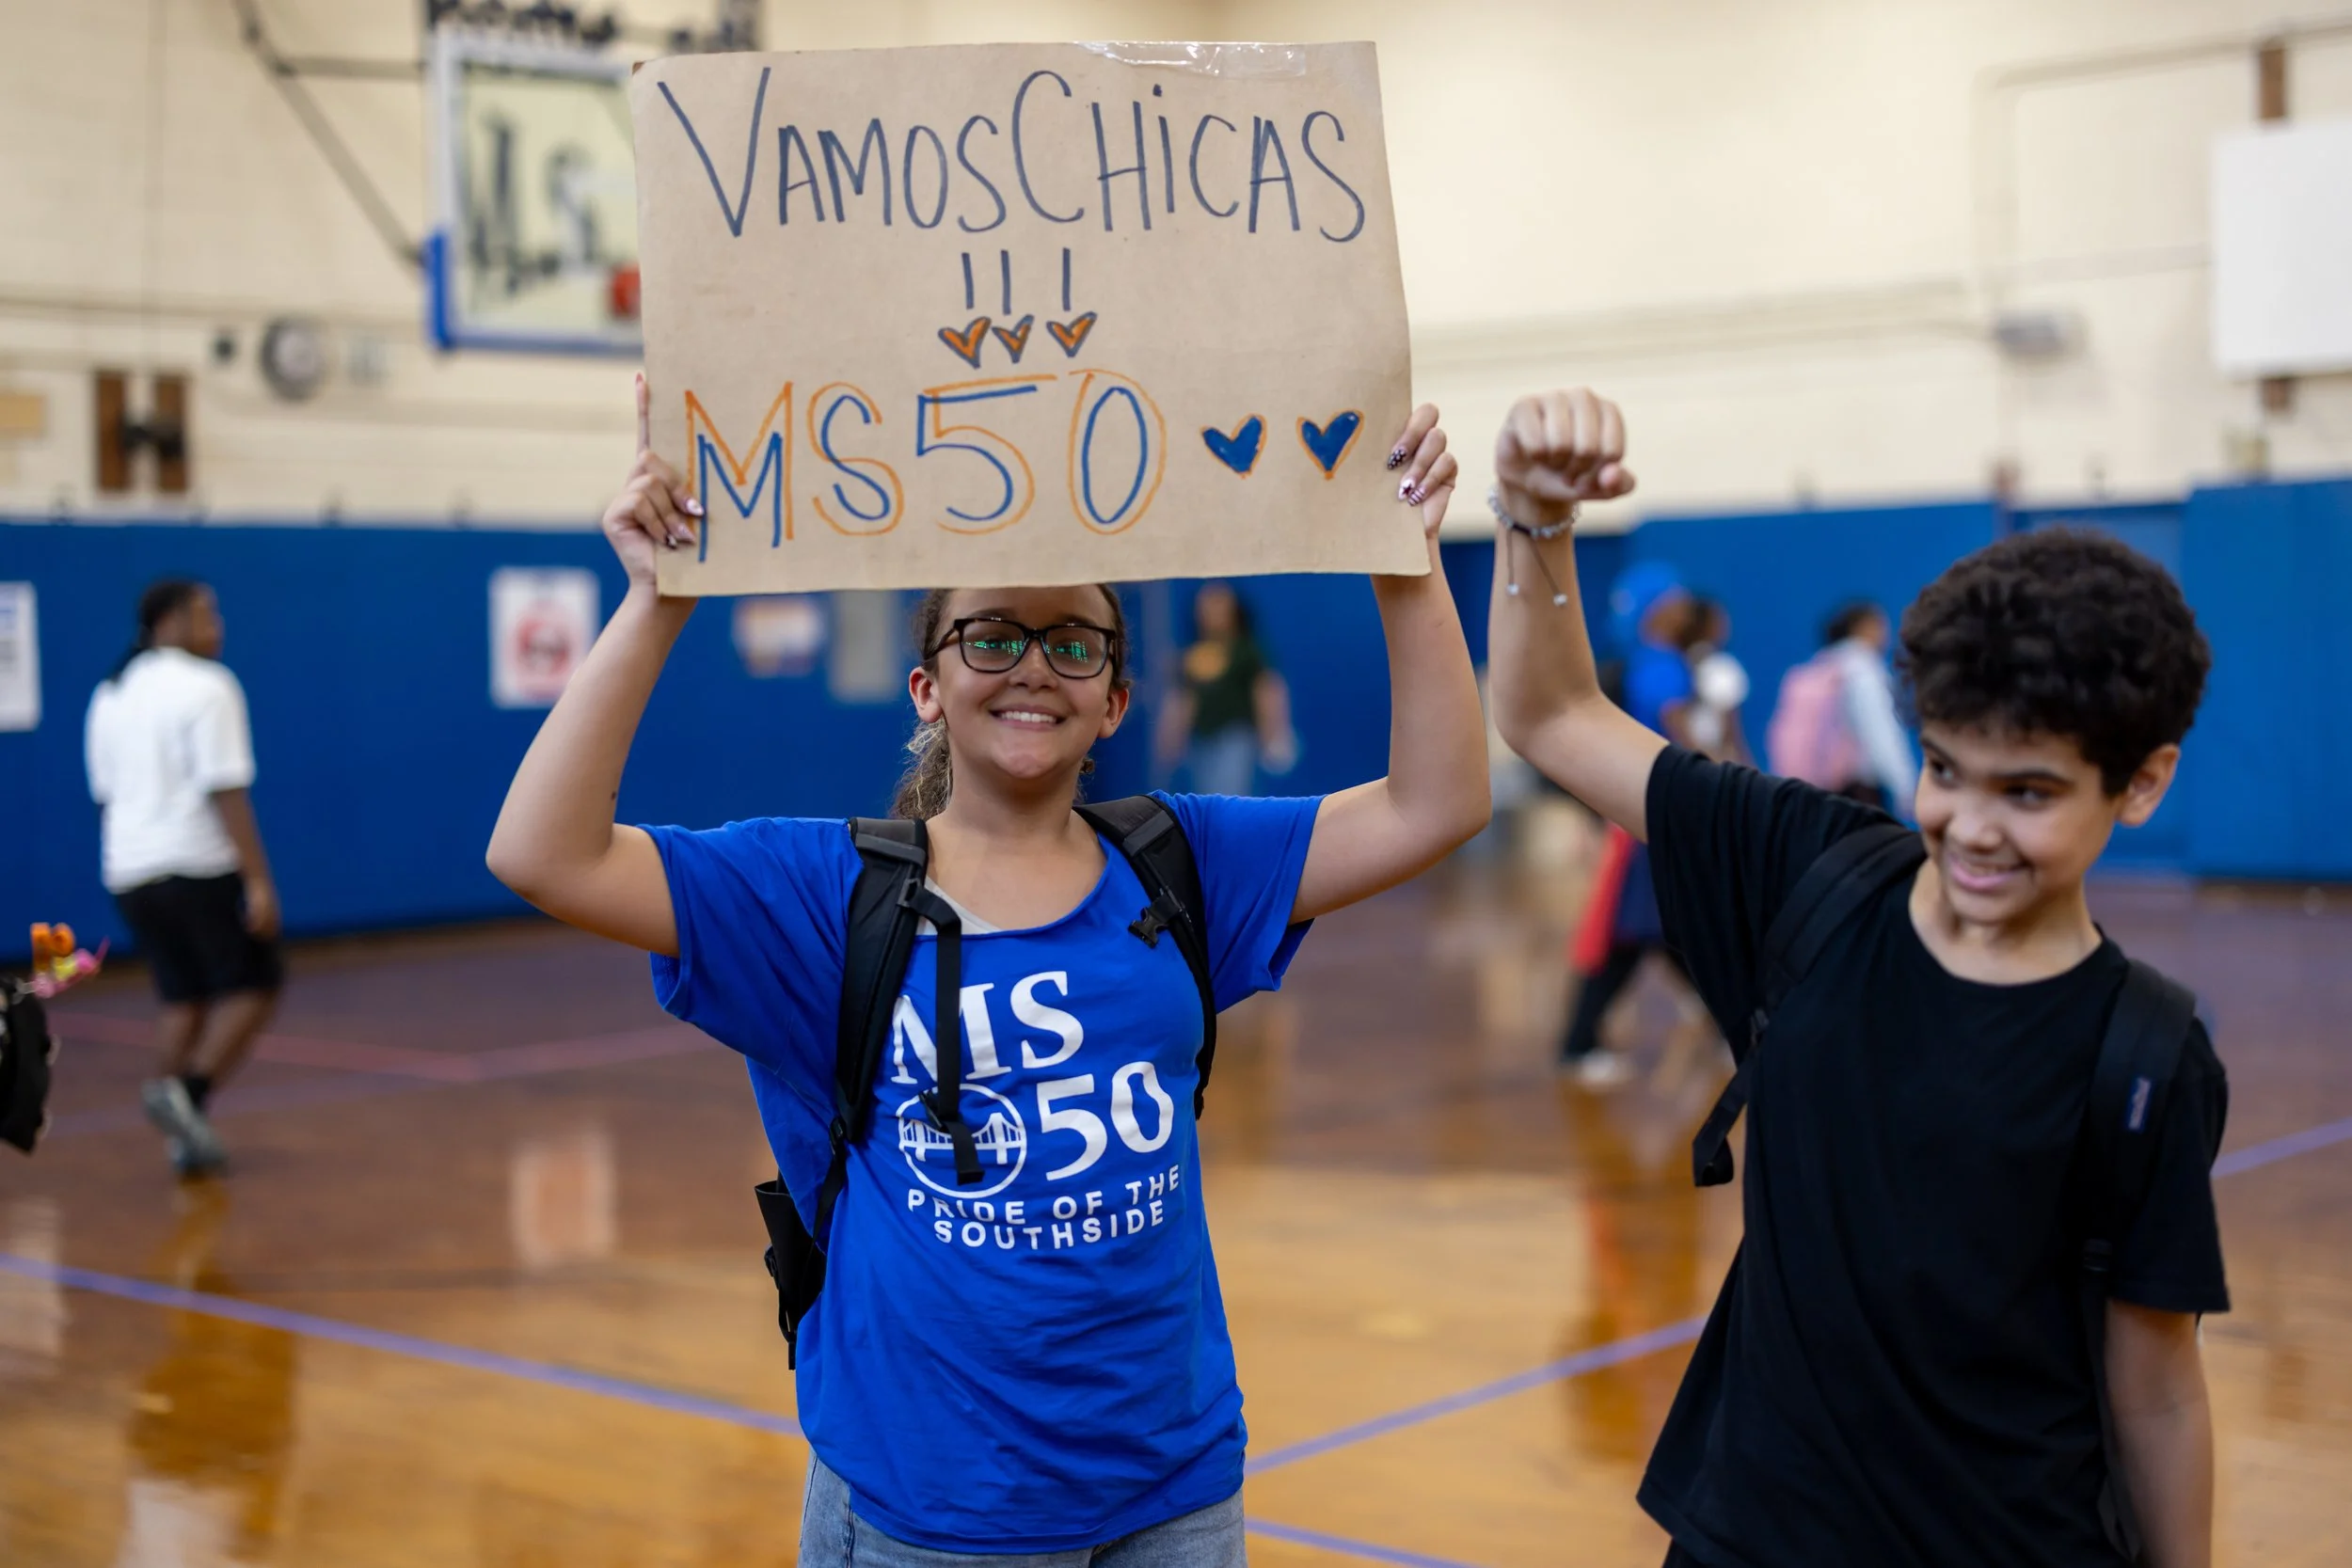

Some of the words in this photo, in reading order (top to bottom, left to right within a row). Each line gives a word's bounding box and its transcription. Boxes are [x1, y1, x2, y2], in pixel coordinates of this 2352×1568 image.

[891, 971, 1084, 1085] MS
[1036, 1061, 1174, 1181] 50
[908, 1188, 1025, 1225] PRIDE
[1052, 1191, 1103, 1220] OF
[1124, 1164, 1180, 1206] THE
[934, 1199, 1164, 1250] SOUTHSIDE
